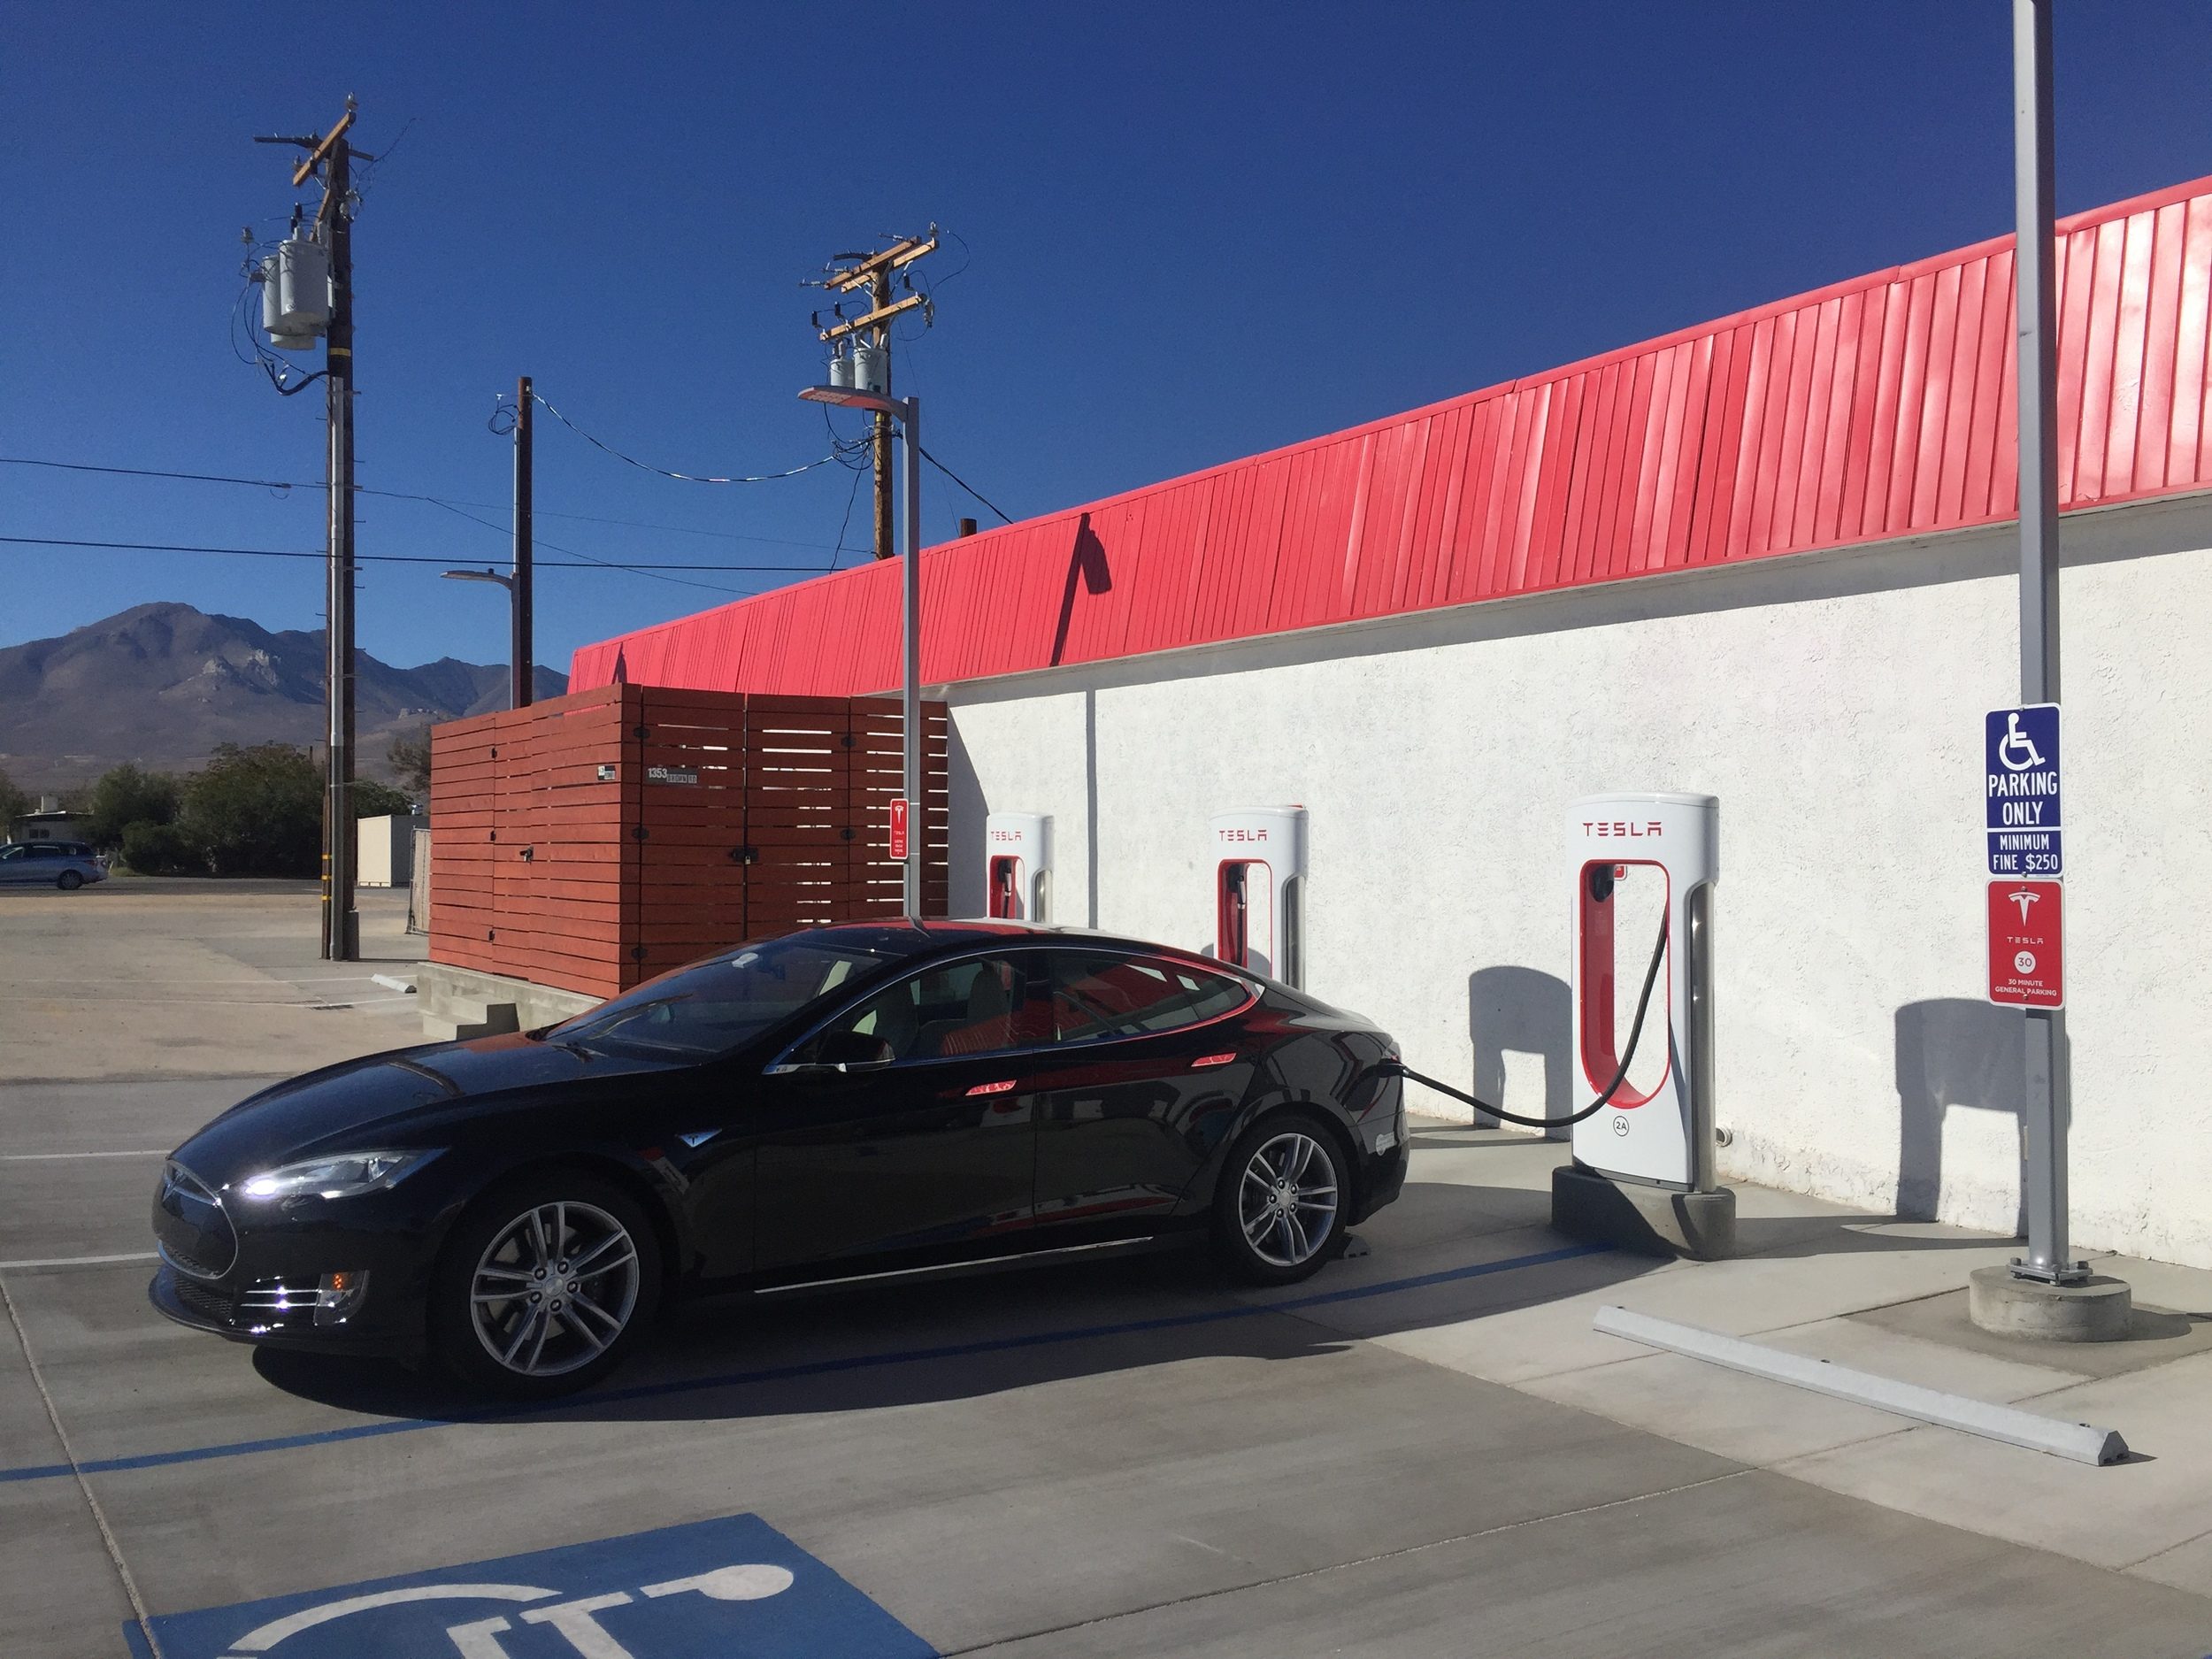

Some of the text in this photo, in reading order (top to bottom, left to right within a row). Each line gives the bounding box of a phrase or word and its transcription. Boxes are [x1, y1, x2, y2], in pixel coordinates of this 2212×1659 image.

[648, 767, 667, 779] 1353
[1988, 771, 2058, 797] PARKING
[2002, 801, 2044, 826] ONLY
[1218, 829, 1267, 841] TESLA
[1582, 821, 1662, 837] TESLA
[990, 831, 1022, 841] TESLA
[2000, 833, 2050, 850] MINIMUM
[1993, 853, 2058, 872] FINE $250
[2017, 957, 2032, 967] 30
[1994, 986, 2057, 996] GENERAL PARKING
[1616, 1121, 1627, 1131] 2A
